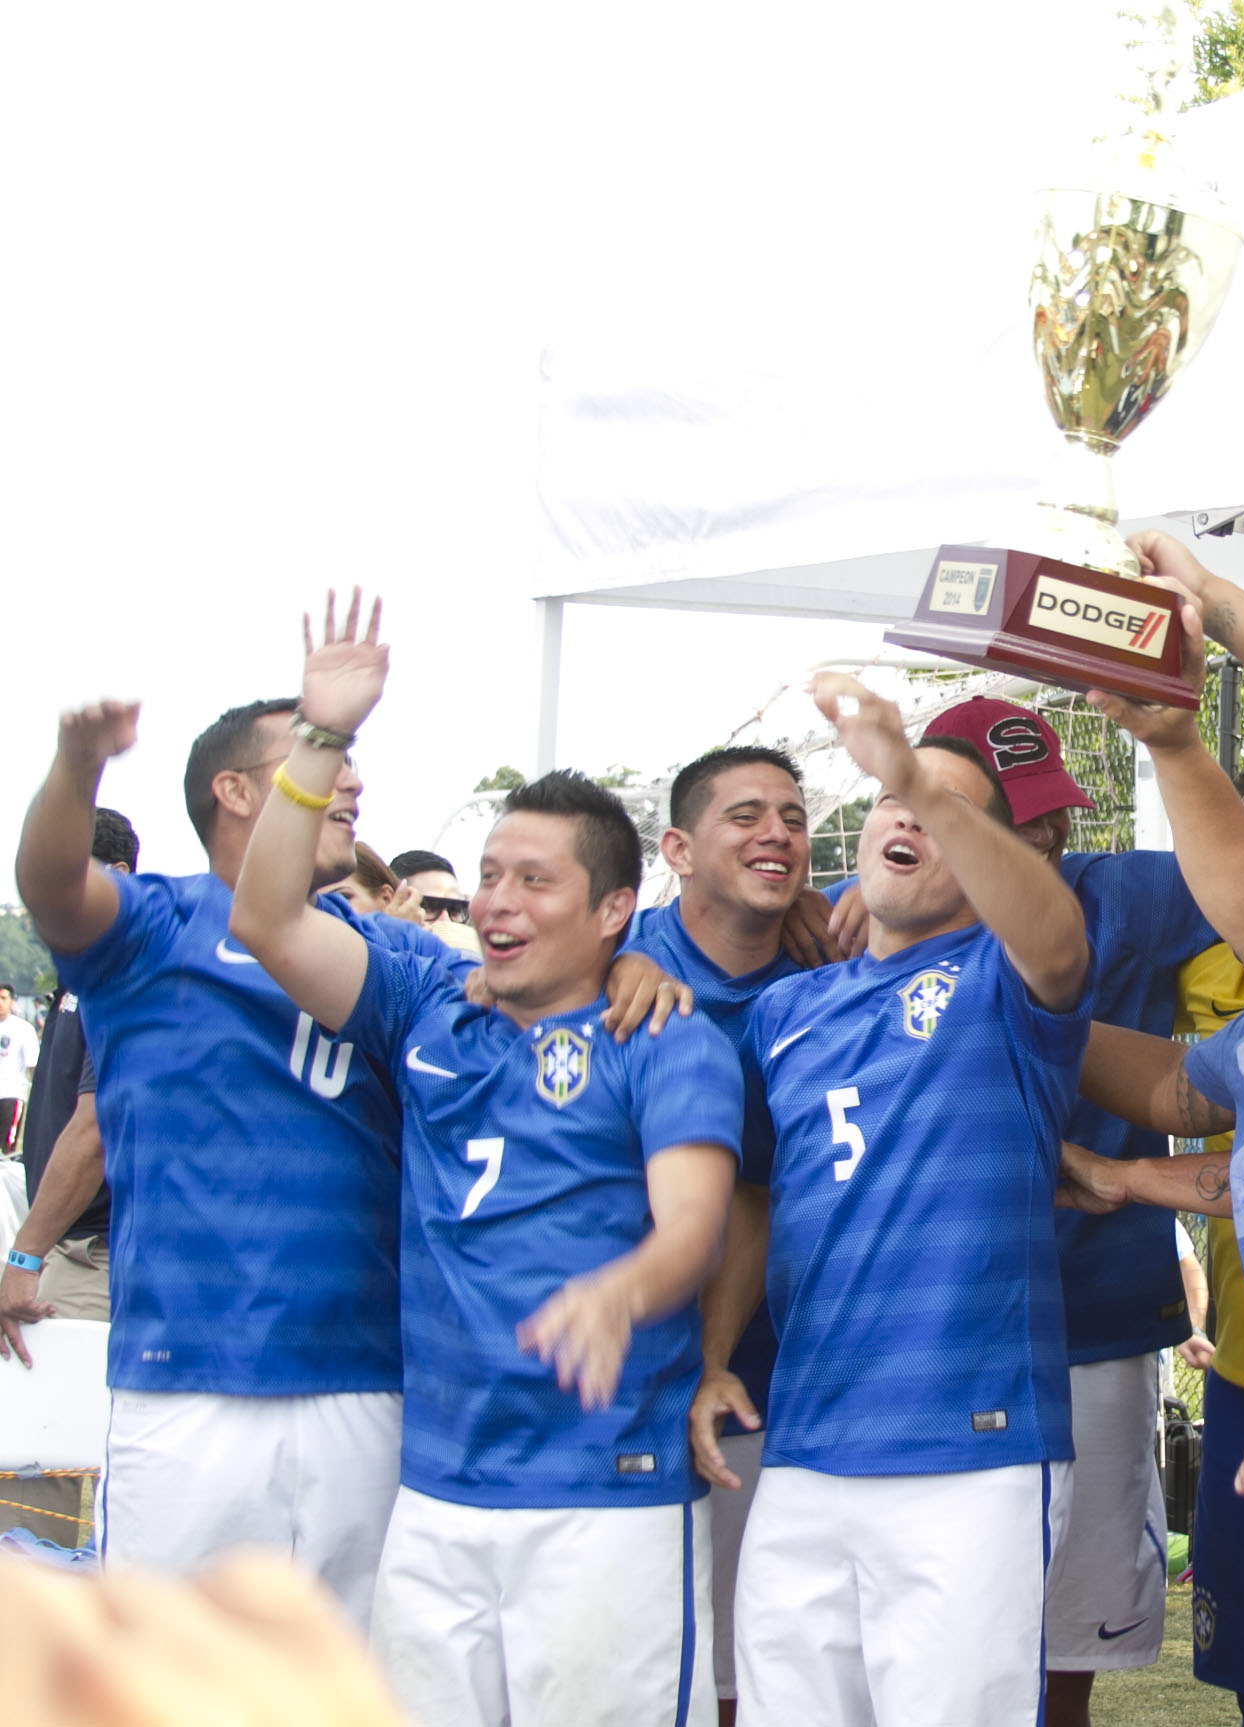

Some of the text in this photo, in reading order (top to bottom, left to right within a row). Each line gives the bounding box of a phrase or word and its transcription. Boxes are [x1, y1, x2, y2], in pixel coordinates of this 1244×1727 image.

[1036, 592, 1147, 636] DODGE
[987, 716, 1048, 772] S
[826, 1086, 867, 1182] 5
[461, 1136, 505, 1220] 7
